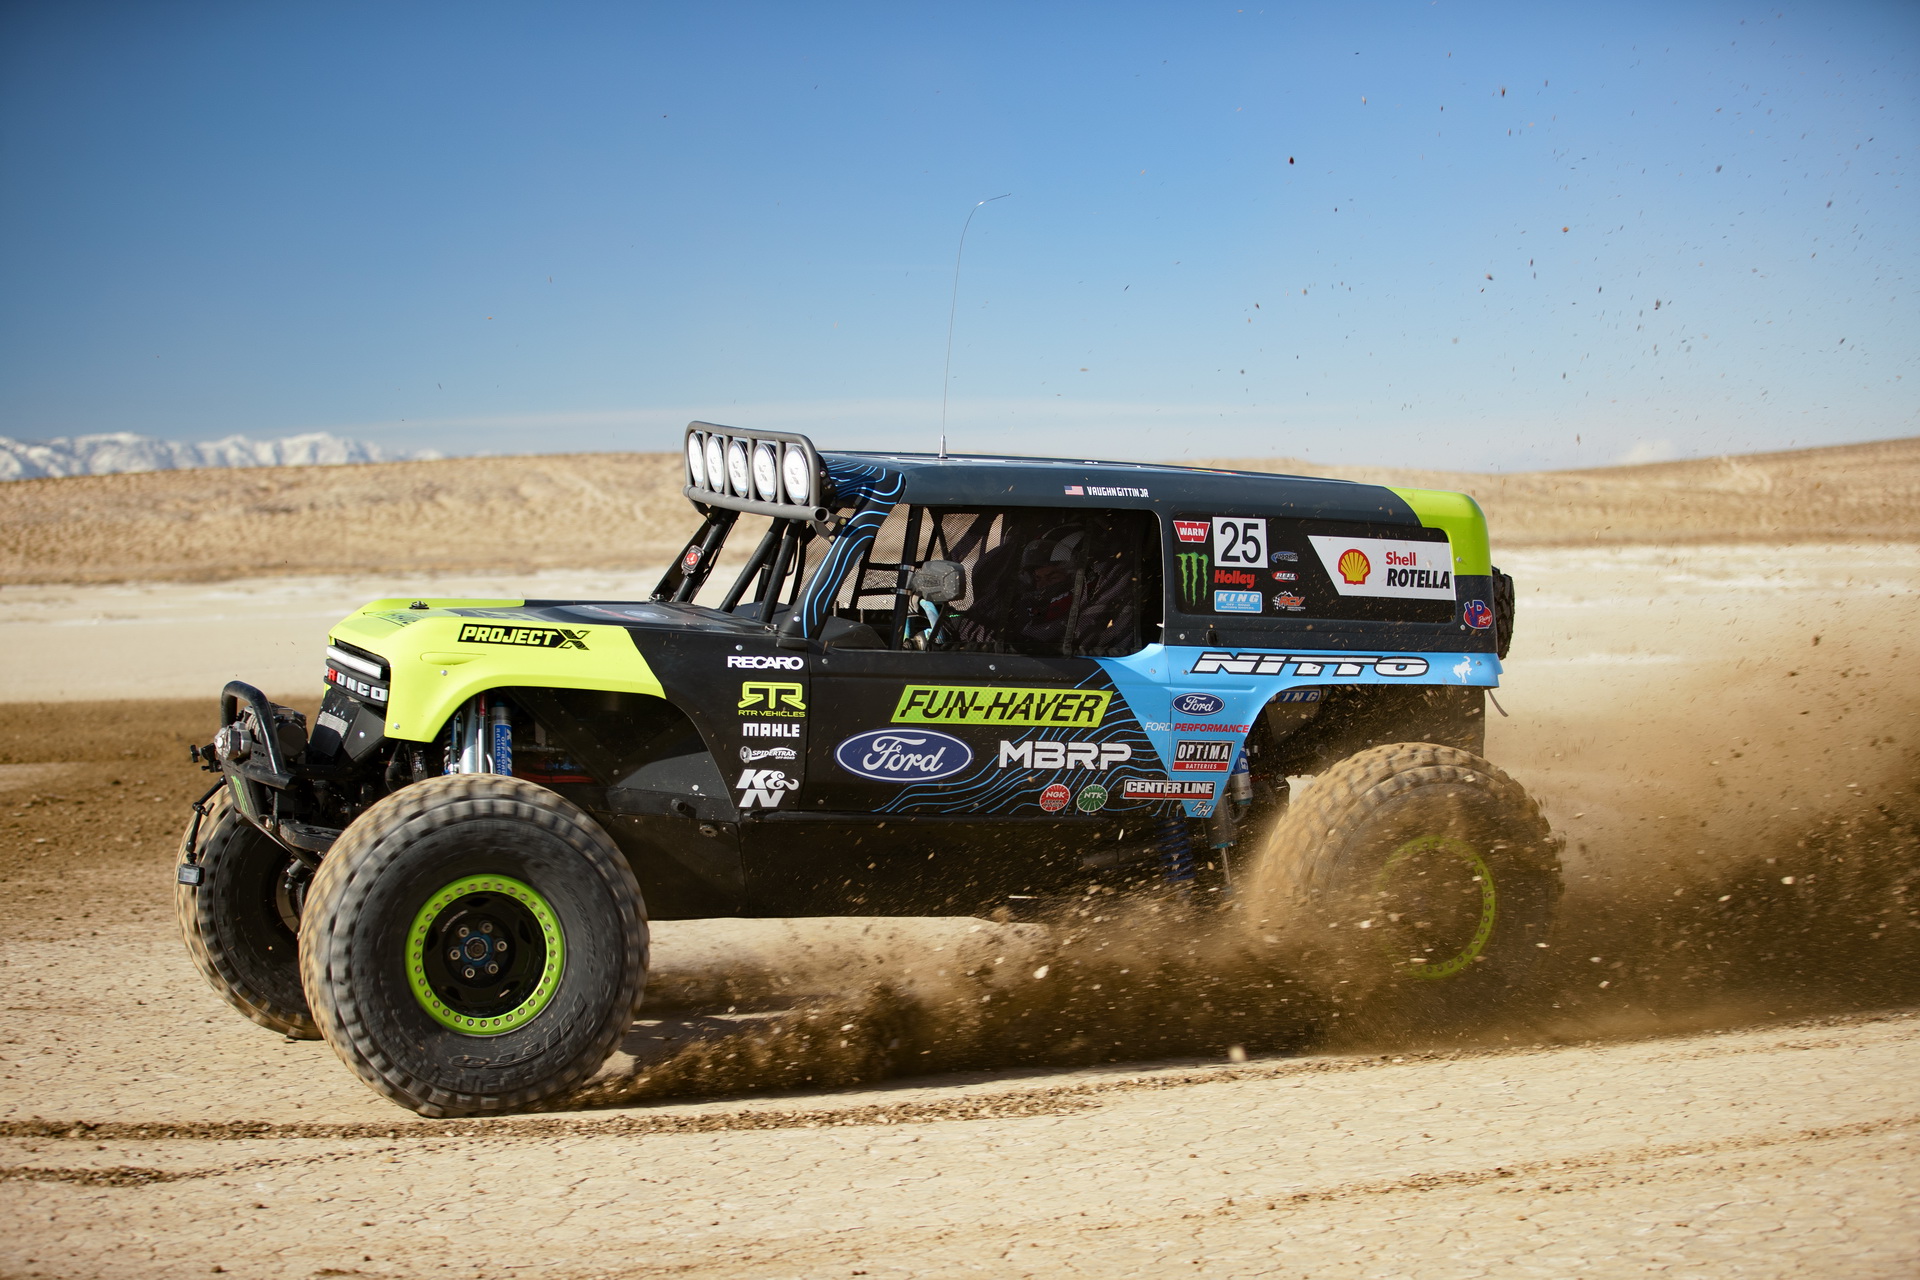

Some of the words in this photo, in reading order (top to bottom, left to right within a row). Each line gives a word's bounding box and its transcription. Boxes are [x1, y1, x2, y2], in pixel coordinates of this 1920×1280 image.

[1087, 486, 1117, 496] VAUGHN
[1117, 487, 1139, 497] GITTIN
[1140, 488, 1150, 498] JR
[1179, 527, 1205, 537] WARN
[1220, 521, 1261, 564] 25
[1386, 551, 1417, 566] Shell
[1214, 569, 1255, 589] Holley
[1386, 569, 1450, 590] ROTELLA
[1217, 592, 1260, 603] KING
[1280, 596, 1306, 607] RCV
[463, 627, 559, 647] PROJECT
[727, 655, 804, 670] RECARO
[1190, 651, 1430, 677] NITTO
[899, 689, 1104, 723] FUN-HAVER
[1182, 696, 1214, 713] Ford
[758, 710, 806, 718] VEHICLES
[742, 722, 800, 738] MAHLE
[1144, 721, 1172, 732] FORD
[1174, 722, 1250, 733] PERFORMANCE
[752, 749, 798, 758] SPIDERTRAX
[862, 735, 947, 773] Ford
[998, 740, 1132, 771] MBRP
[1177, 744, 1230, 761] OPTIMA
[1185, 763, 1218, 771] BATTERIES
[1045, 791, 1067, 799] NGK
[1083, 791, 1104, 799] NTK
[1126, 780, 1182, 794] CENTER
[1183, 782, 1214, 795] LINE
